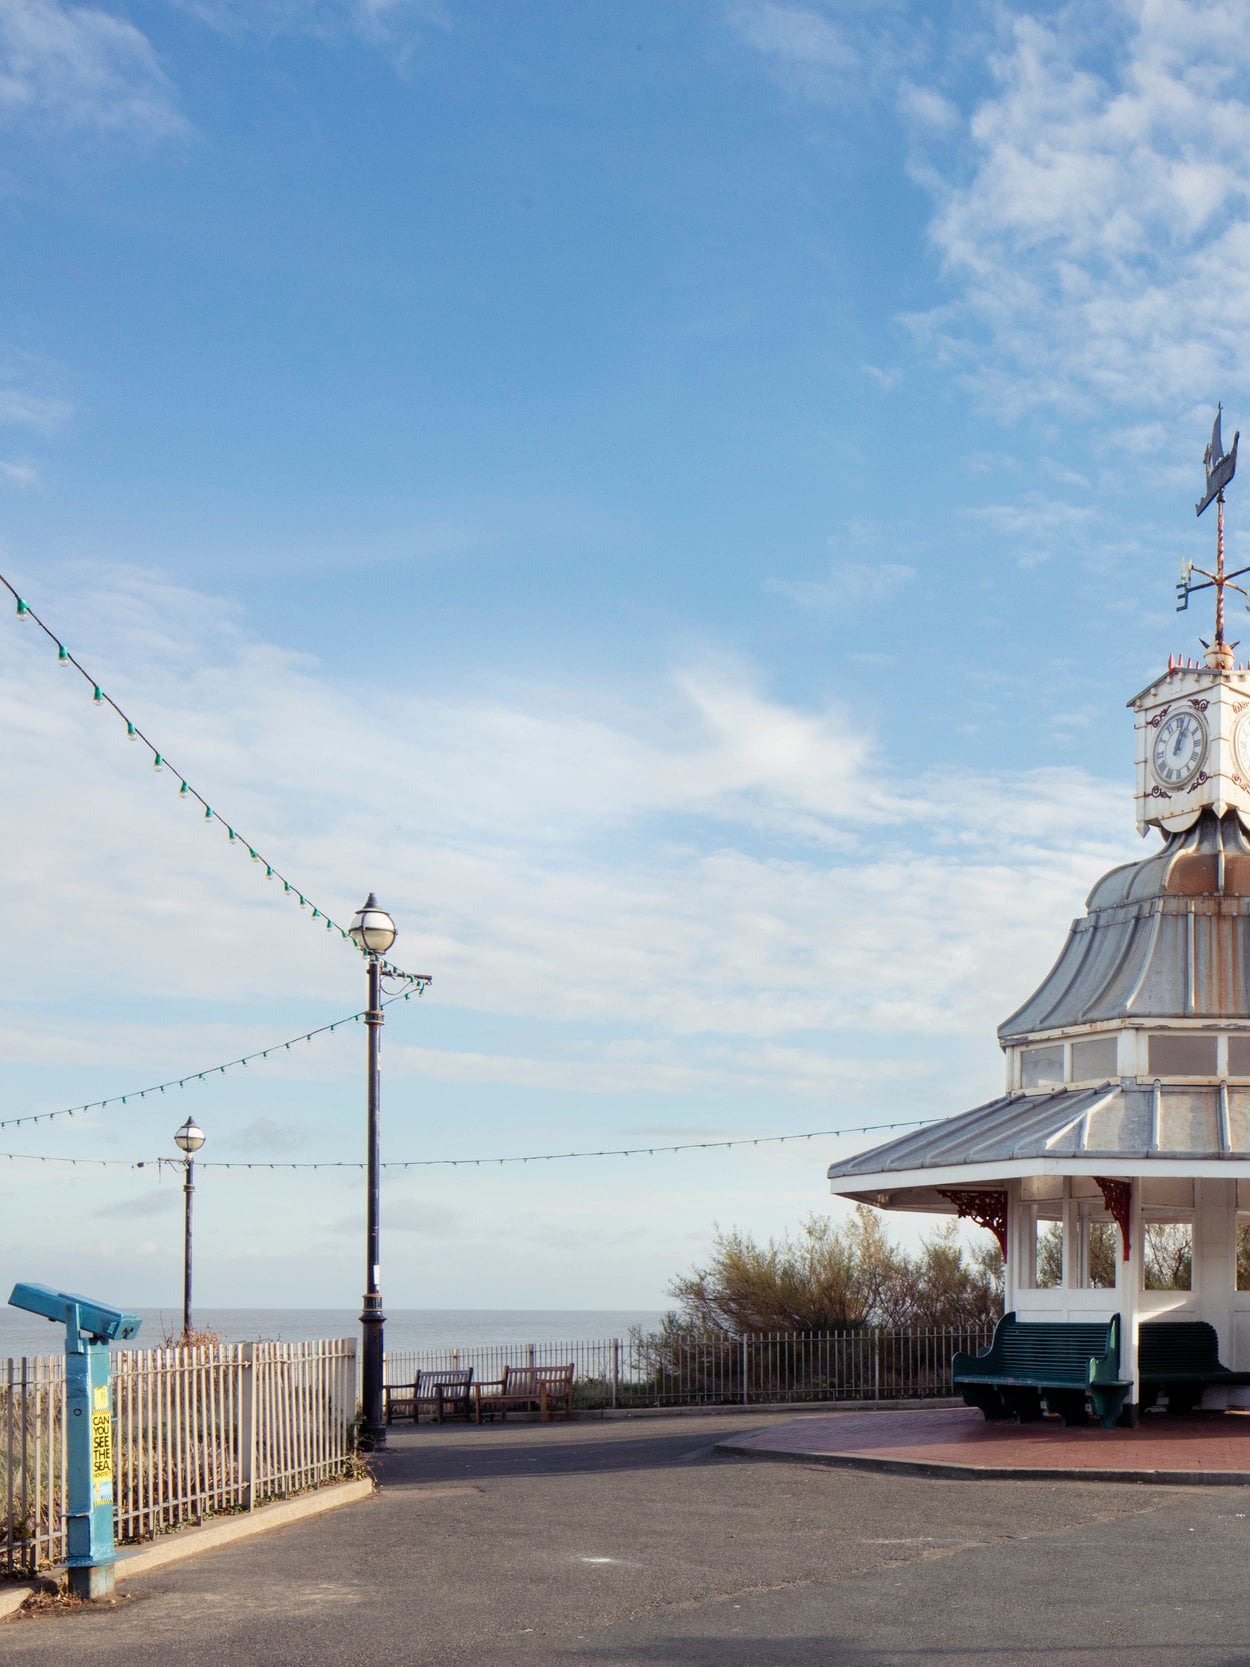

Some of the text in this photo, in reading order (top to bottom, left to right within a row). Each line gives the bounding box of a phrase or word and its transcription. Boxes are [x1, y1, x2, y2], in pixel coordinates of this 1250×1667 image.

[92, 1416, 110, 1426] CAN
[93, 1426, 109, 1436] YOU
[94, 1436, 109, 1449] SEE
[94, 1448, 110, 1460] THE
[94, 1460, 110, 1472] SEA
